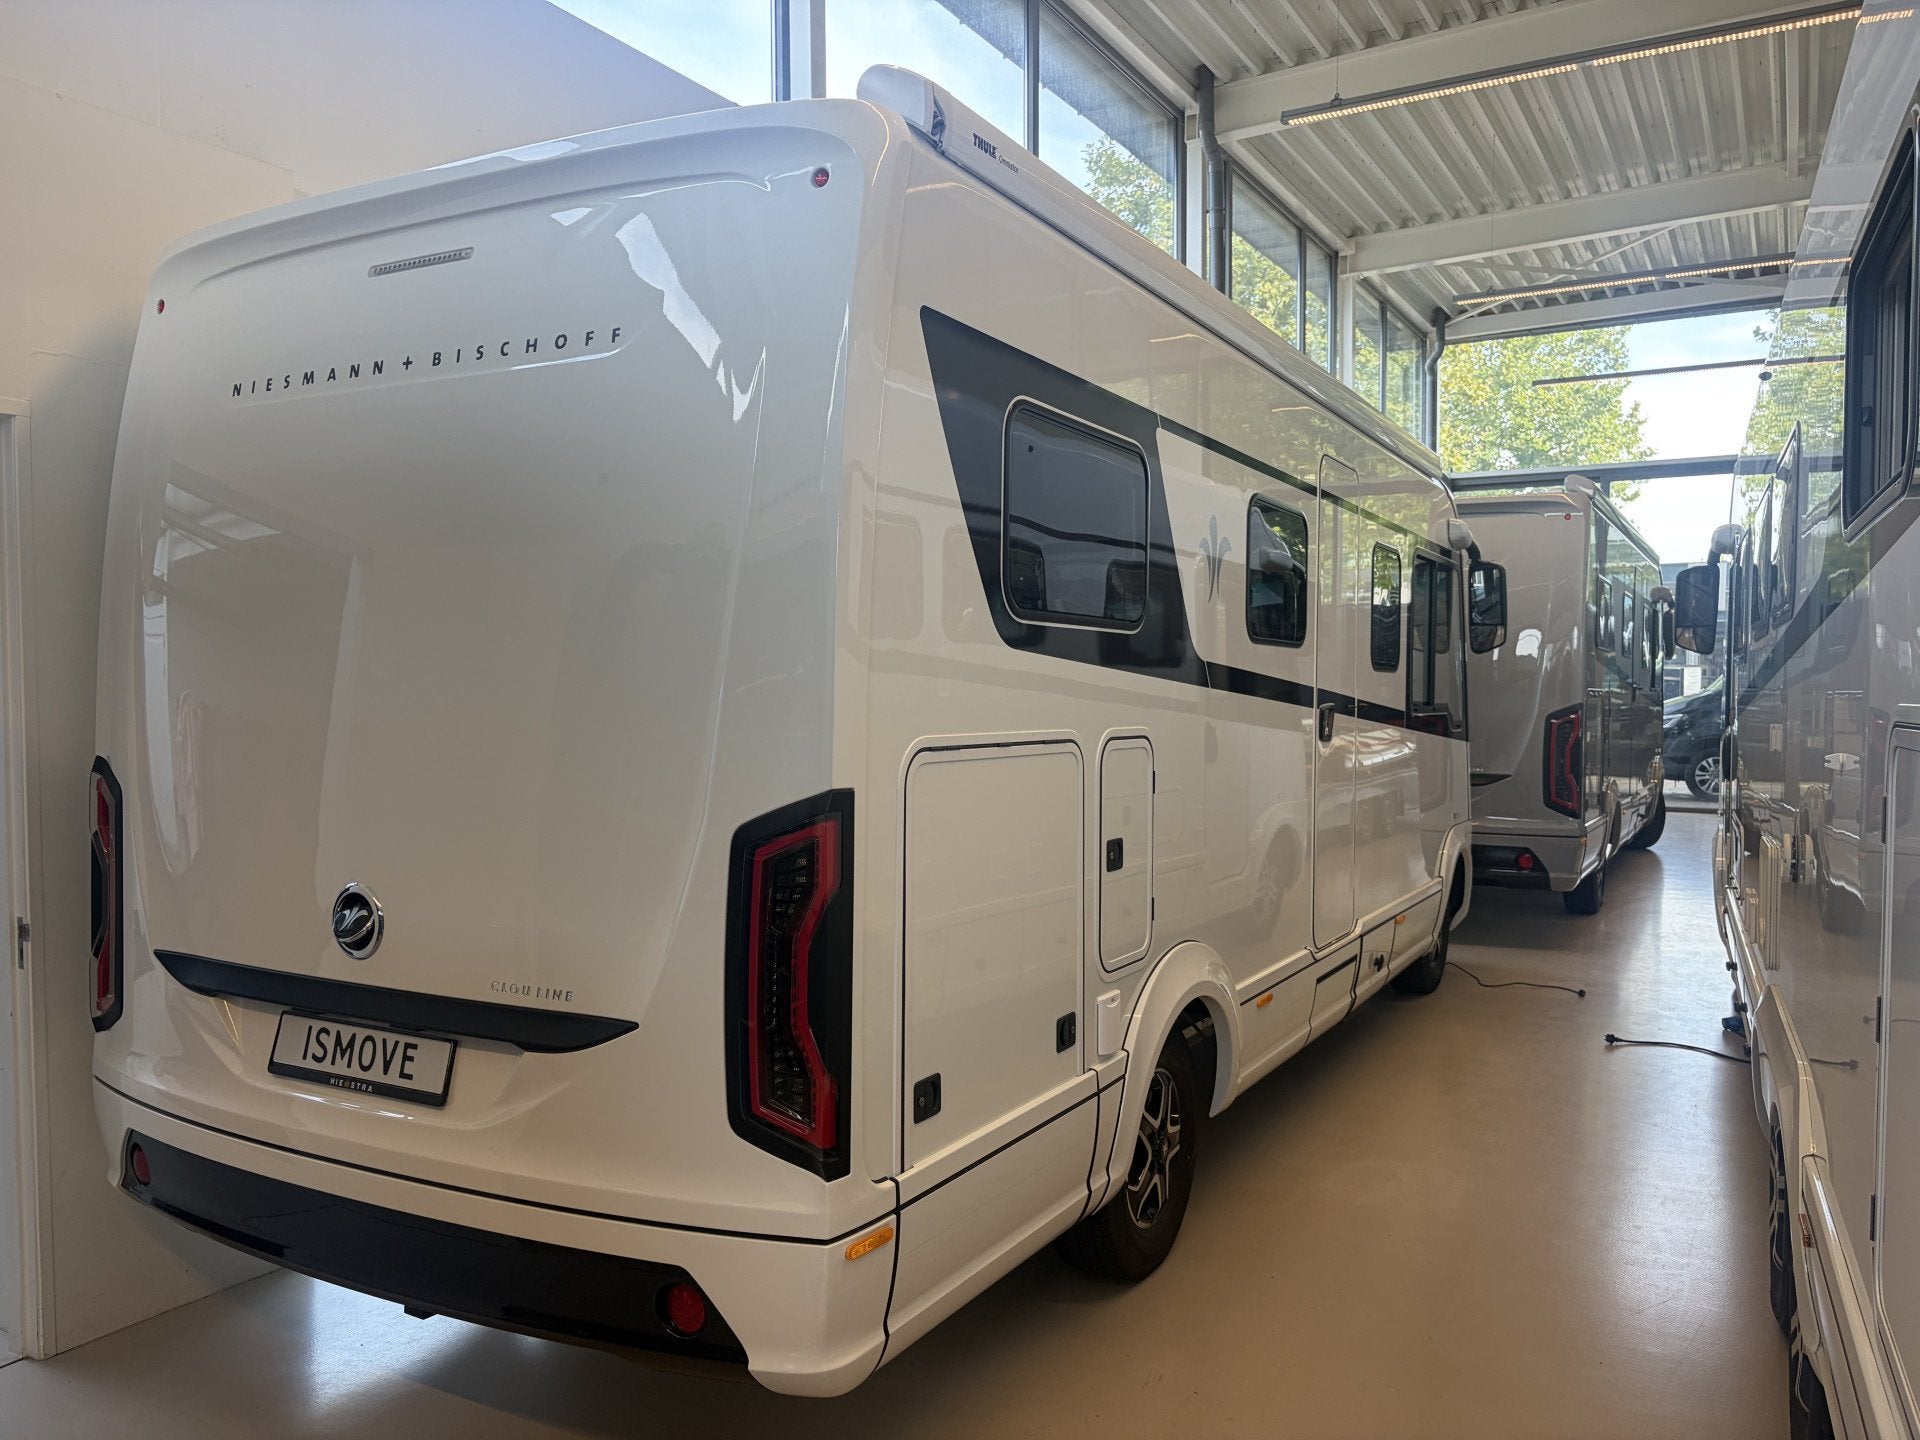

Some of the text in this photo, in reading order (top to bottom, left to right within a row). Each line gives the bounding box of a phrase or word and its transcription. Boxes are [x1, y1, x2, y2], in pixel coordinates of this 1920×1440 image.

[972, 132, 997, 160] THULE
[232, 327, 621, 397] NIESMANN + BISCHOFF
[490, 980, 574, 1002] CLOU LINE
[302, 1025, 418, 1081] ISMOVE
